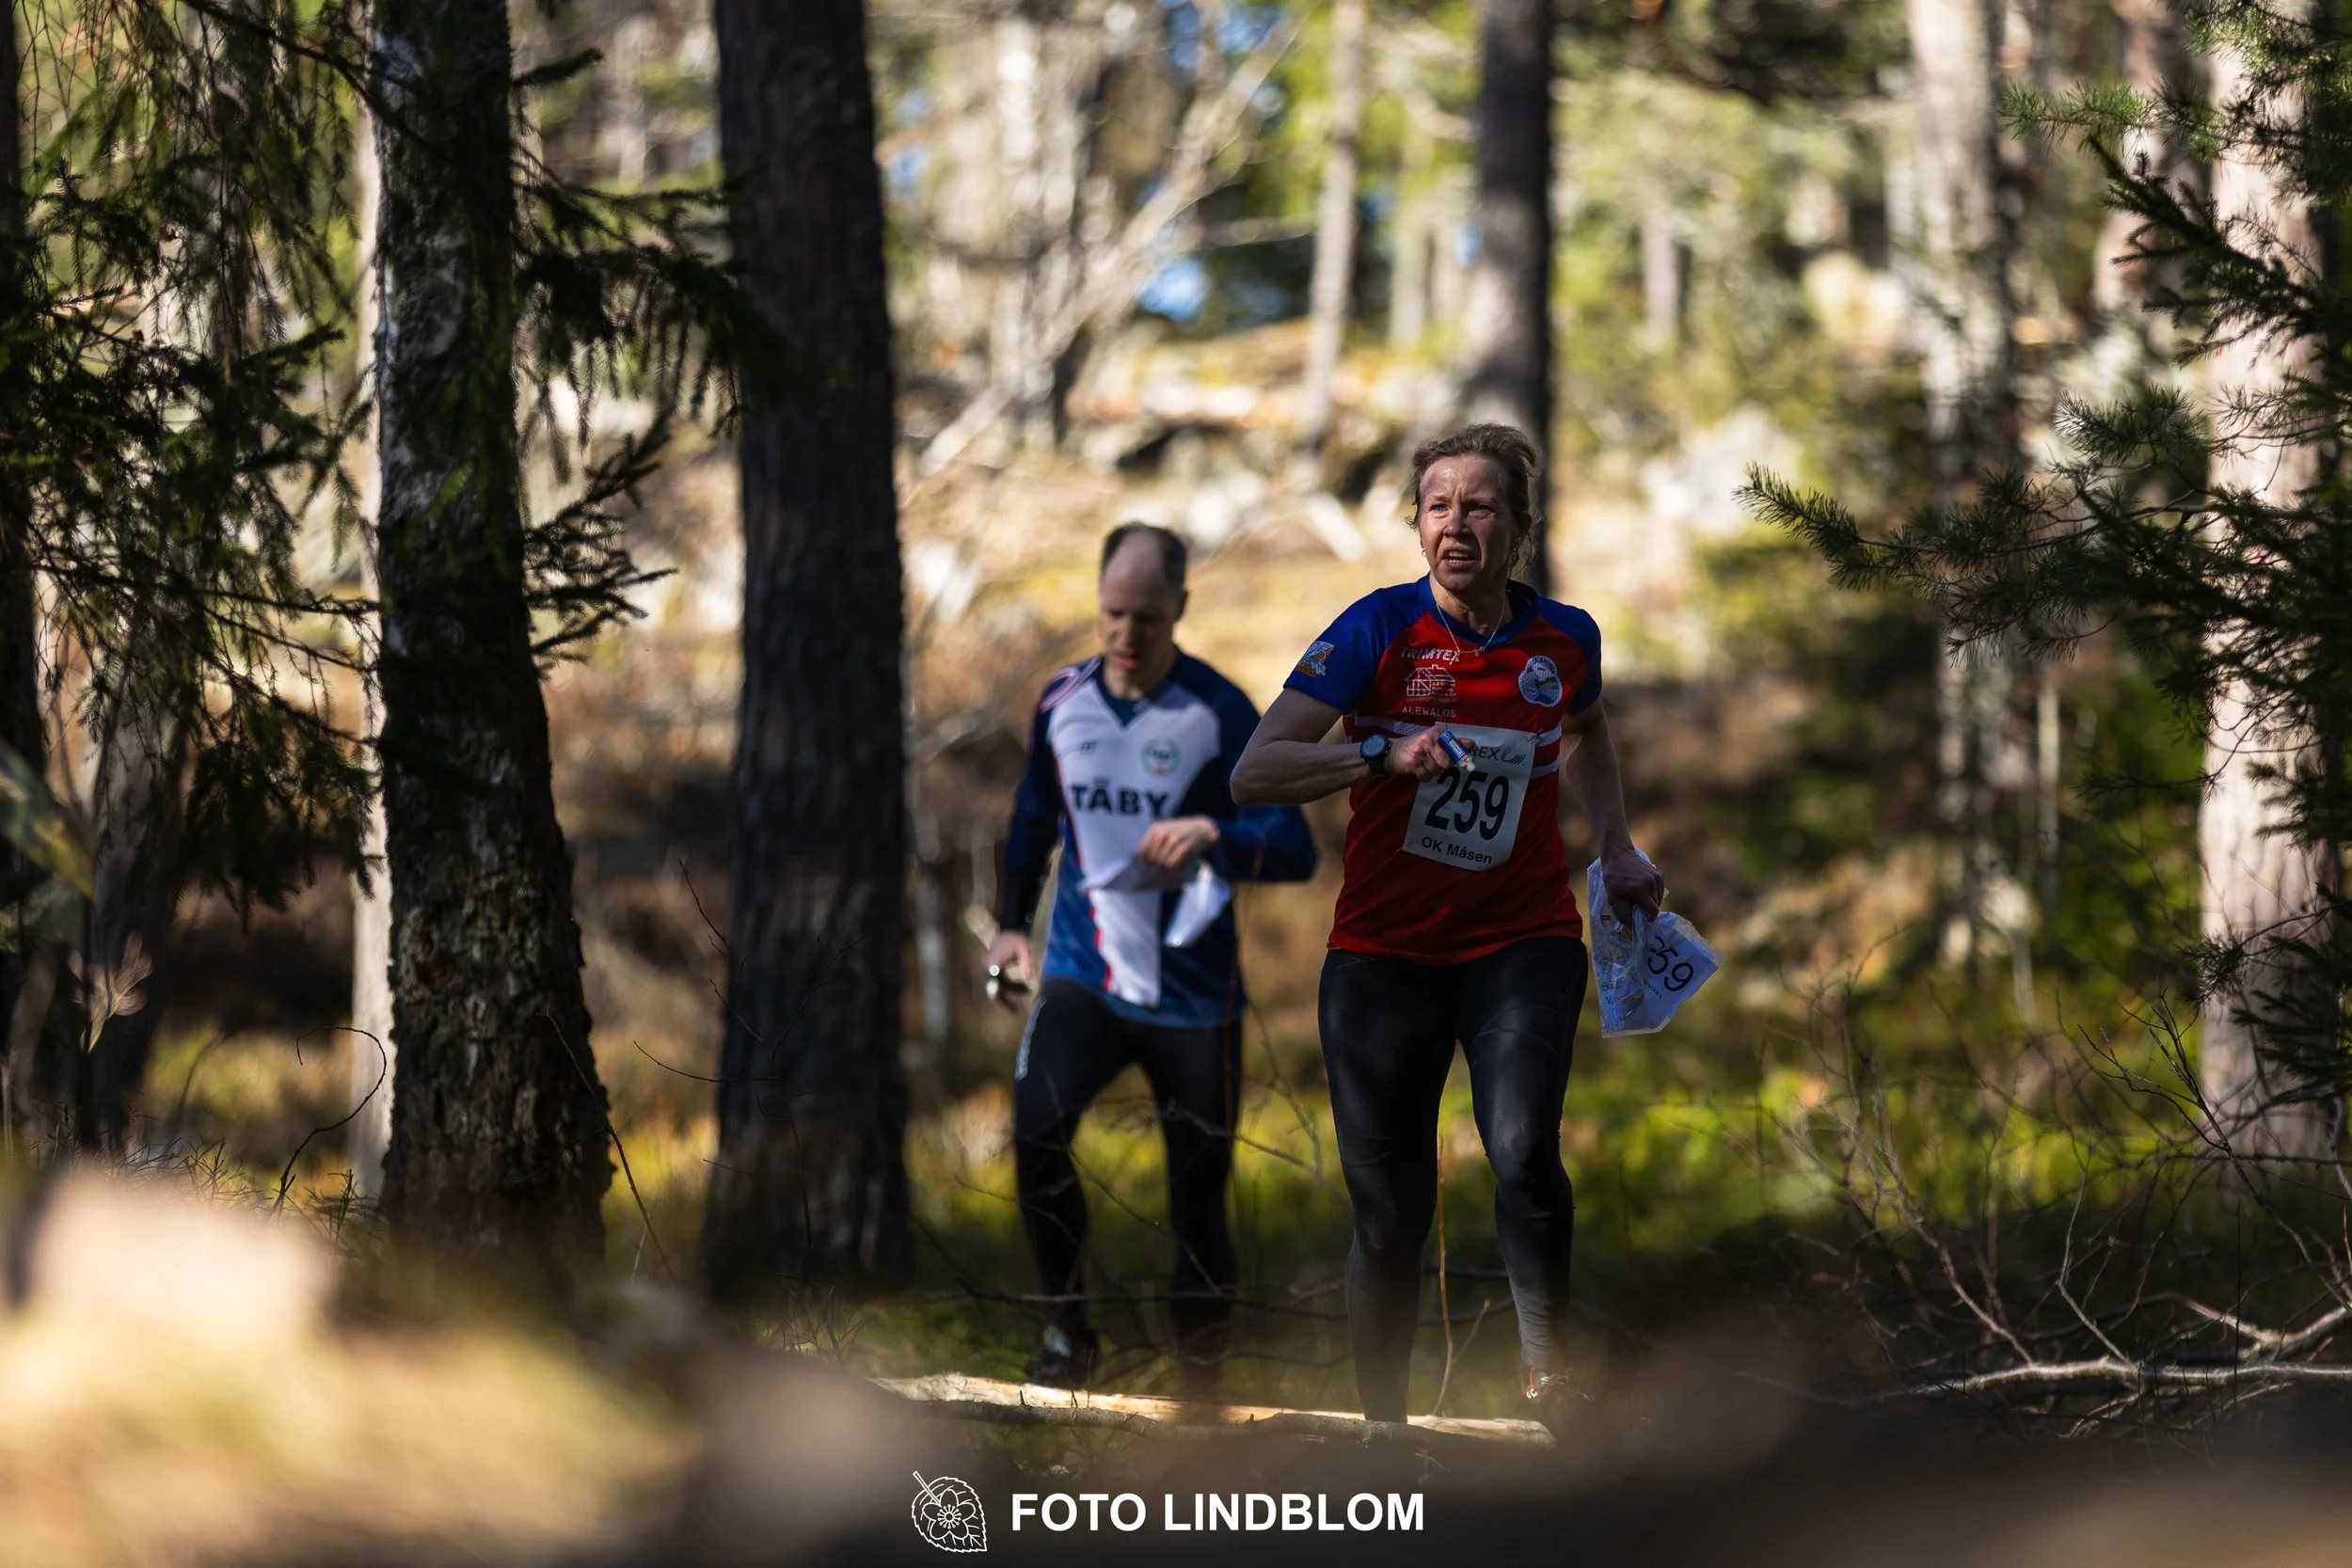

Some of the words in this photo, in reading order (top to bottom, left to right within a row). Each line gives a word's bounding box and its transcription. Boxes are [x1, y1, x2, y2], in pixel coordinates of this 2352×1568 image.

[1401, 646, 1460, 662] TRIMTEX
[1071, 779, 1168, 818] TÄBY
[1424, 769, 1510, 841] 259
[1422, 837, 1442, 854] OK
[1446, 844, 1493, 864] Måsen
